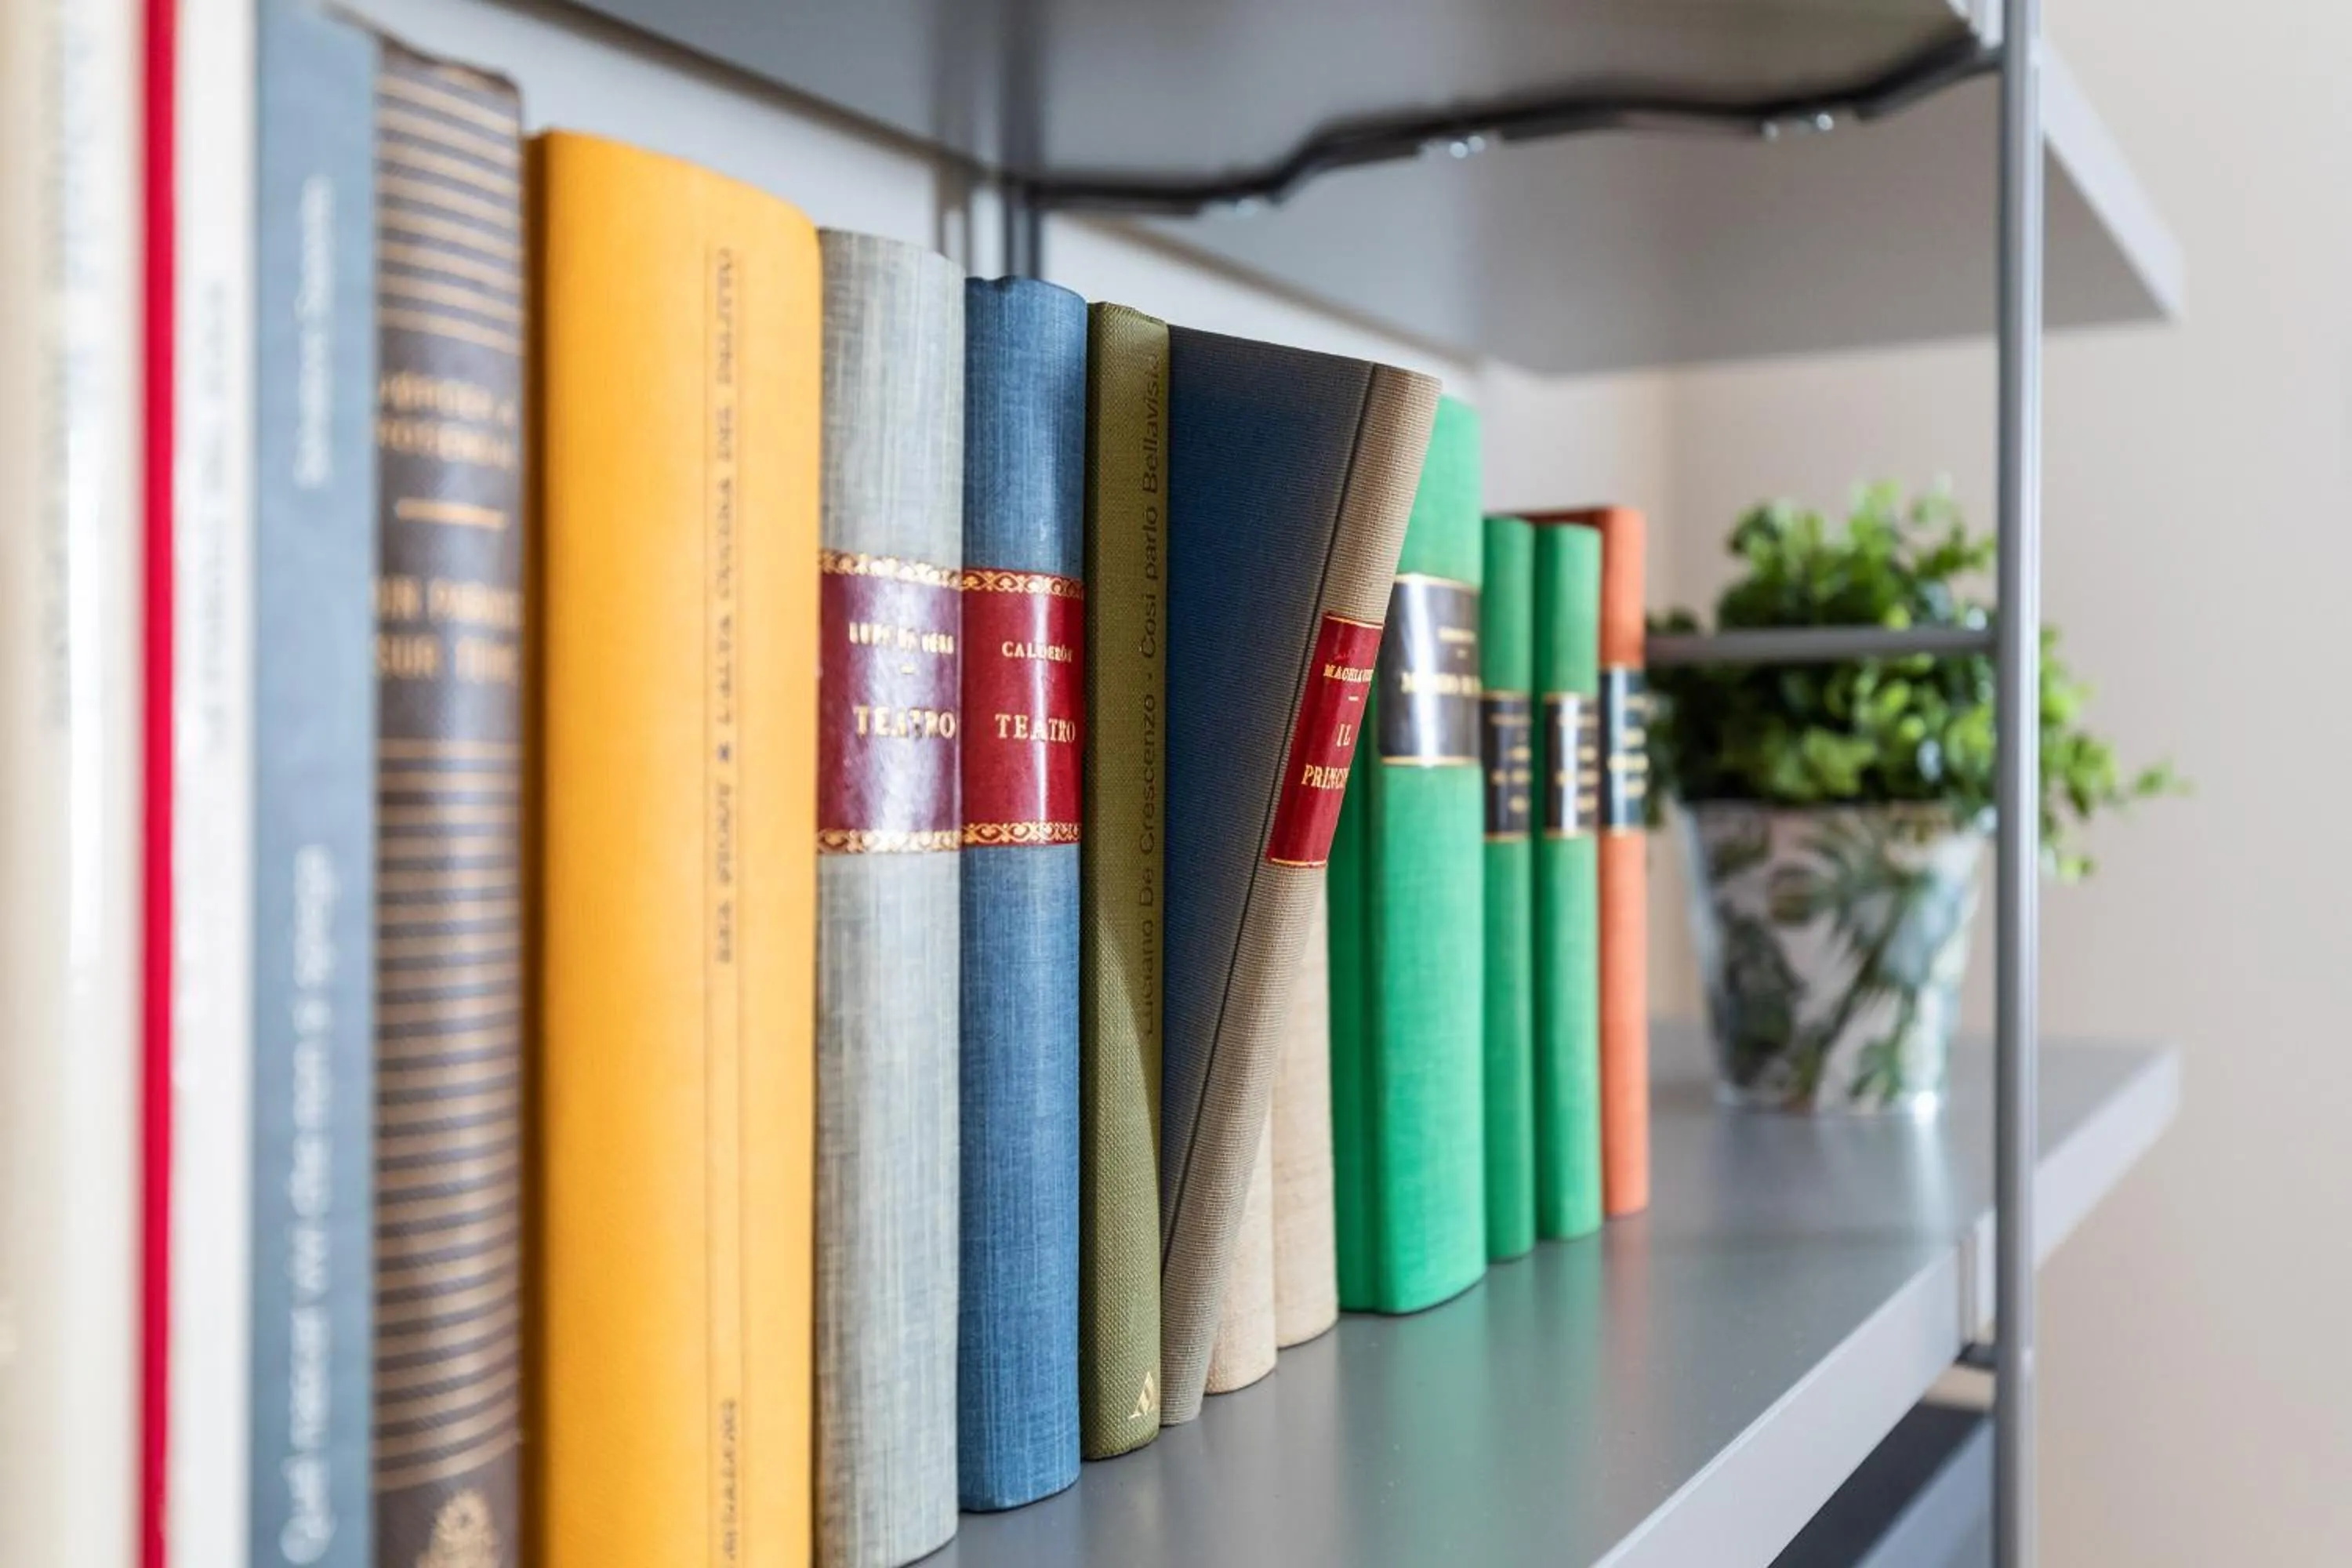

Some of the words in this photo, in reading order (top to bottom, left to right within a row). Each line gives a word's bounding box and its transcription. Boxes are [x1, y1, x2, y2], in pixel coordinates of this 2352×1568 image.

[853, 705, 956, 741] TEATRO
[995, 713, 1076, 742] TEATRO
[1336, 723, 1352, 747] IL
[1139, 694, 1156, 856] Crescenzo
[1139, 867, 1154, 907] De
